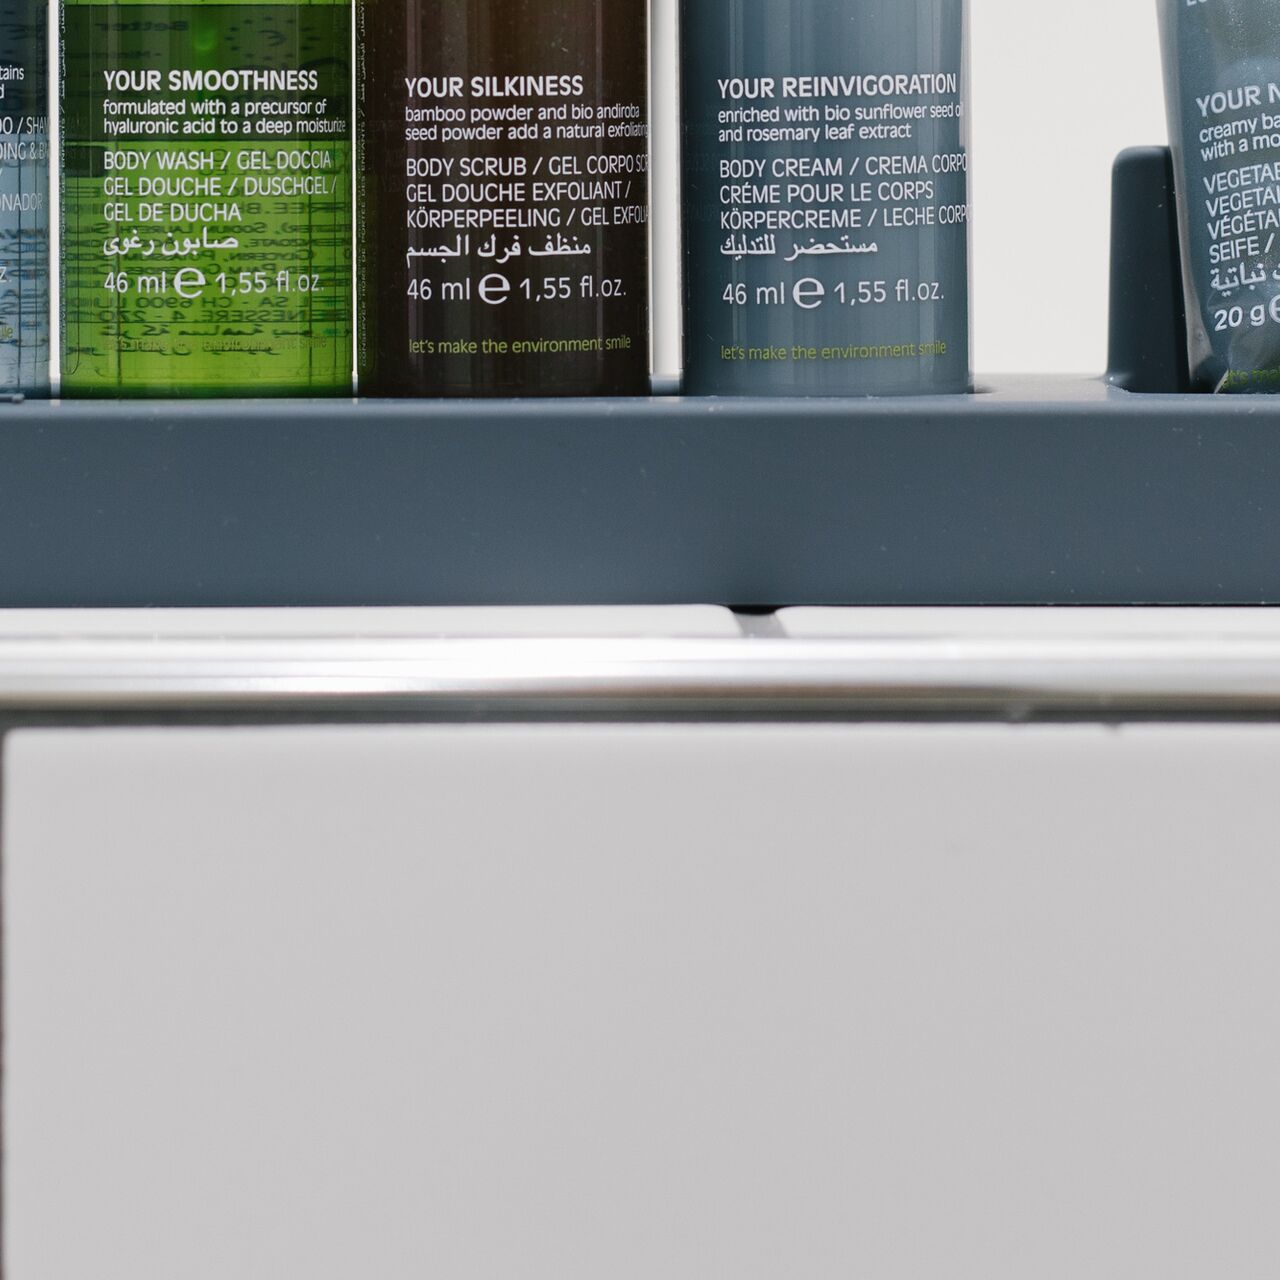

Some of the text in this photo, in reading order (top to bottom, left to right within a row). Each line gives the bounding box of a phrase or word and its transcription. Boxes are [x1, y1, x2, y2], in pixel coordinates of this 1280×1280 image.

[104, 70, 318, 91] YOUR SMOOTHNESS
[405, 75, 583, 98] YOUR SILKINESS
[717, 73, 957, 100] YOUR REINVIGORATION
[103, 99, 312, 117] formulated with precursor
[1195, 85, 1261, 118] YOUR
[406, 103, 639, 123] bamboo powder and bio andiroba
[718, 106, 780, 124] enriched
[784, 105, 819, 122] with
[825, 105, 850, 121] bio
[855, 104, 926, 120] sunflower
[930, 102, 953, 118] seed
[103, 118, 292, 135] hyaluronic acid deep
[405, 123, 604, 142] seed powder add natural
[718, 123, 912, 143] and rosemary leaf extract
[1199, 117, 1257, 143] creamy
[104, 151, 332, 170] BODY WASH GEL DOCCIA
[1200, 140, 1234, 162] with
[407, 155, 633, 177] BODY SCRUB GEL CORPO
[720, 159, 766, 179] BODY
[772, 158, 842, 177] CREAM
[865, 155, 928, 175] CREMA
[104, 176, 328, 196] GEL DOUCHE DUSCHGEL
[407, 181, 622, 203] GEL DOUCHE EXFOLIANT
[787, 183, 844, 203] POUR
[851, 183, 872, 202] LE
[878, 181, 933, 201] CORPS
[104, 203, 242, 222] GEL DE DUCHA
[407, 207, 609, 228] KÖRPERPEELING GEL
[721, 207, 935, 230] KÖRPERCREME LECHE
[1209, 236, 1260, 265] SEIFE
[104, 271, 128, 293] 46
[137, 271, 166, 293] ml
[215, 271, 267, 296] 1,55
[407, 279, 432, 300] 46
[441, 278, 470, 300] ml
[520, 277, 571, 302] 1,55
[723, 283, 747, 305] 46
[756, 282, 785, 305] ml
[833, 281, 886, 306] 1,55
[1214, 307, 1243, 331] 20
[438, 337, 602, 353] make the environment
